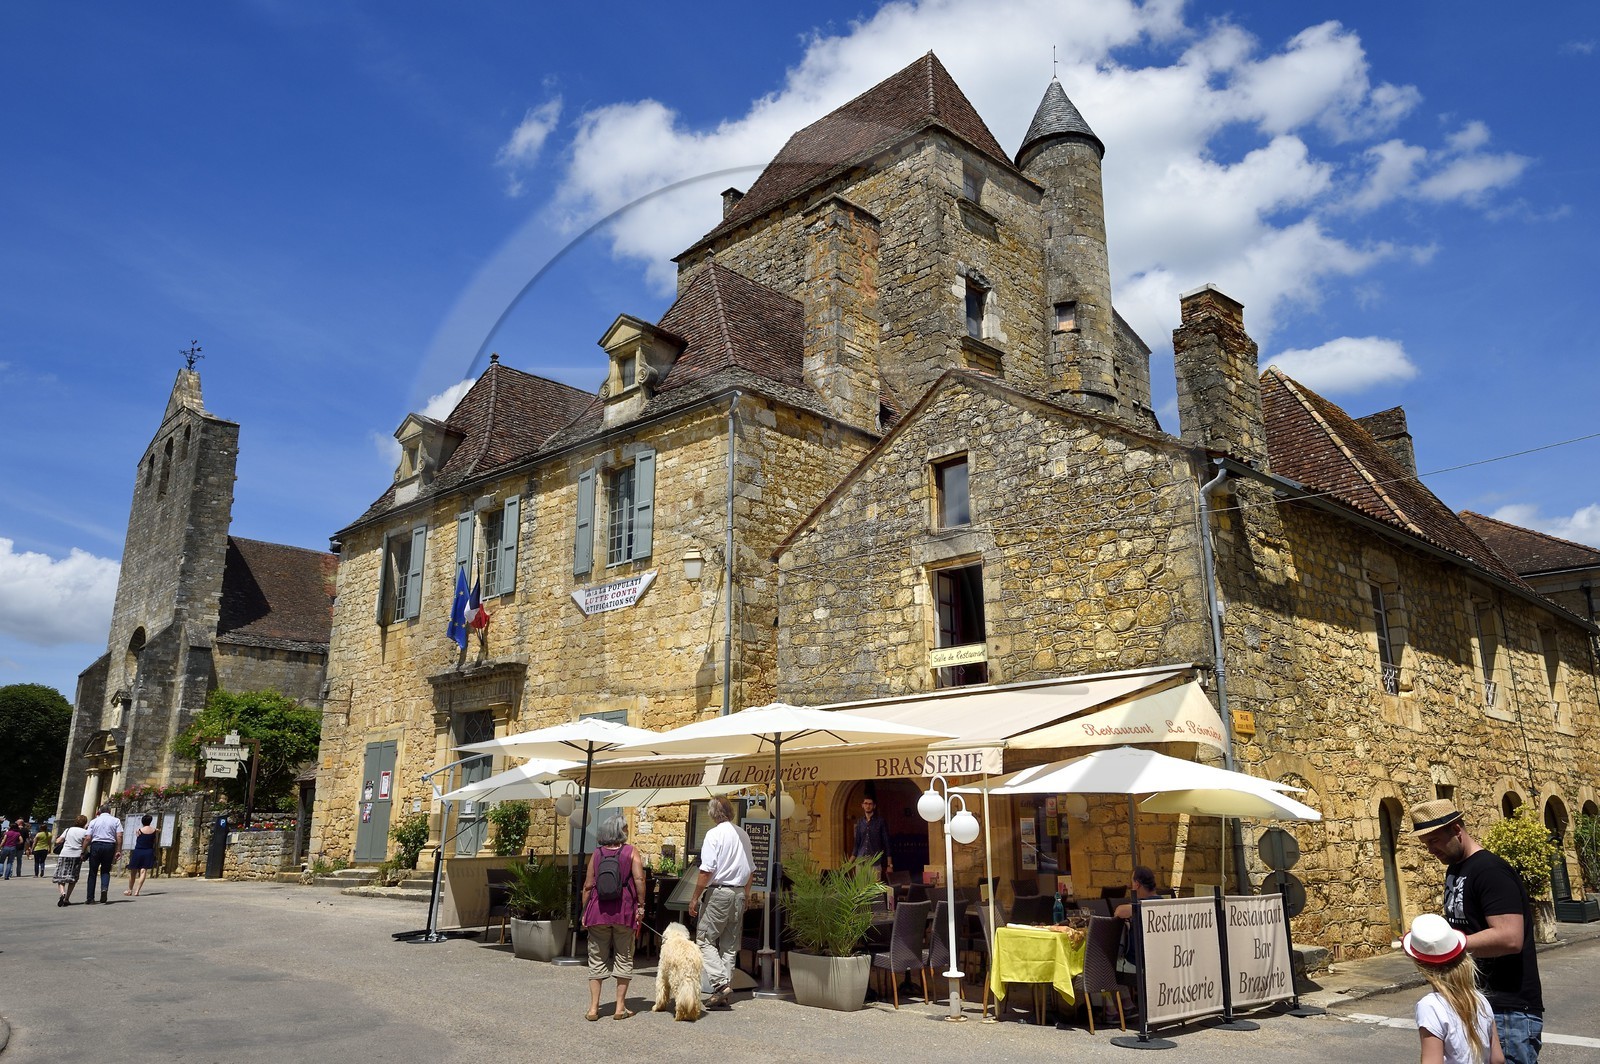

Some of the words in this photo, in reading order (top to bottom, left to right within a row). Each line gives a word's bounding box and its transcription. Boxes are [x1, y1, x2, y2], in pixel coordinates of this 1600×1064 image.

[1082, 723, 1154, 736] Restaurant
[1165, 719, 1185, 734] La
[875, 752, 983, 777] BRASSERIE
[630, 770, 706, 788] Restaurant
[720, 766, 741, 784] La
[745, 824, 761, 834] Plats
[1147, 908, 1213, 934] Restaurant
[1173, 944, 1195, 969] Bar
[1253, 937, 1271, 960] Bar
[1157, 976, 1214, 1007] Brasserie
